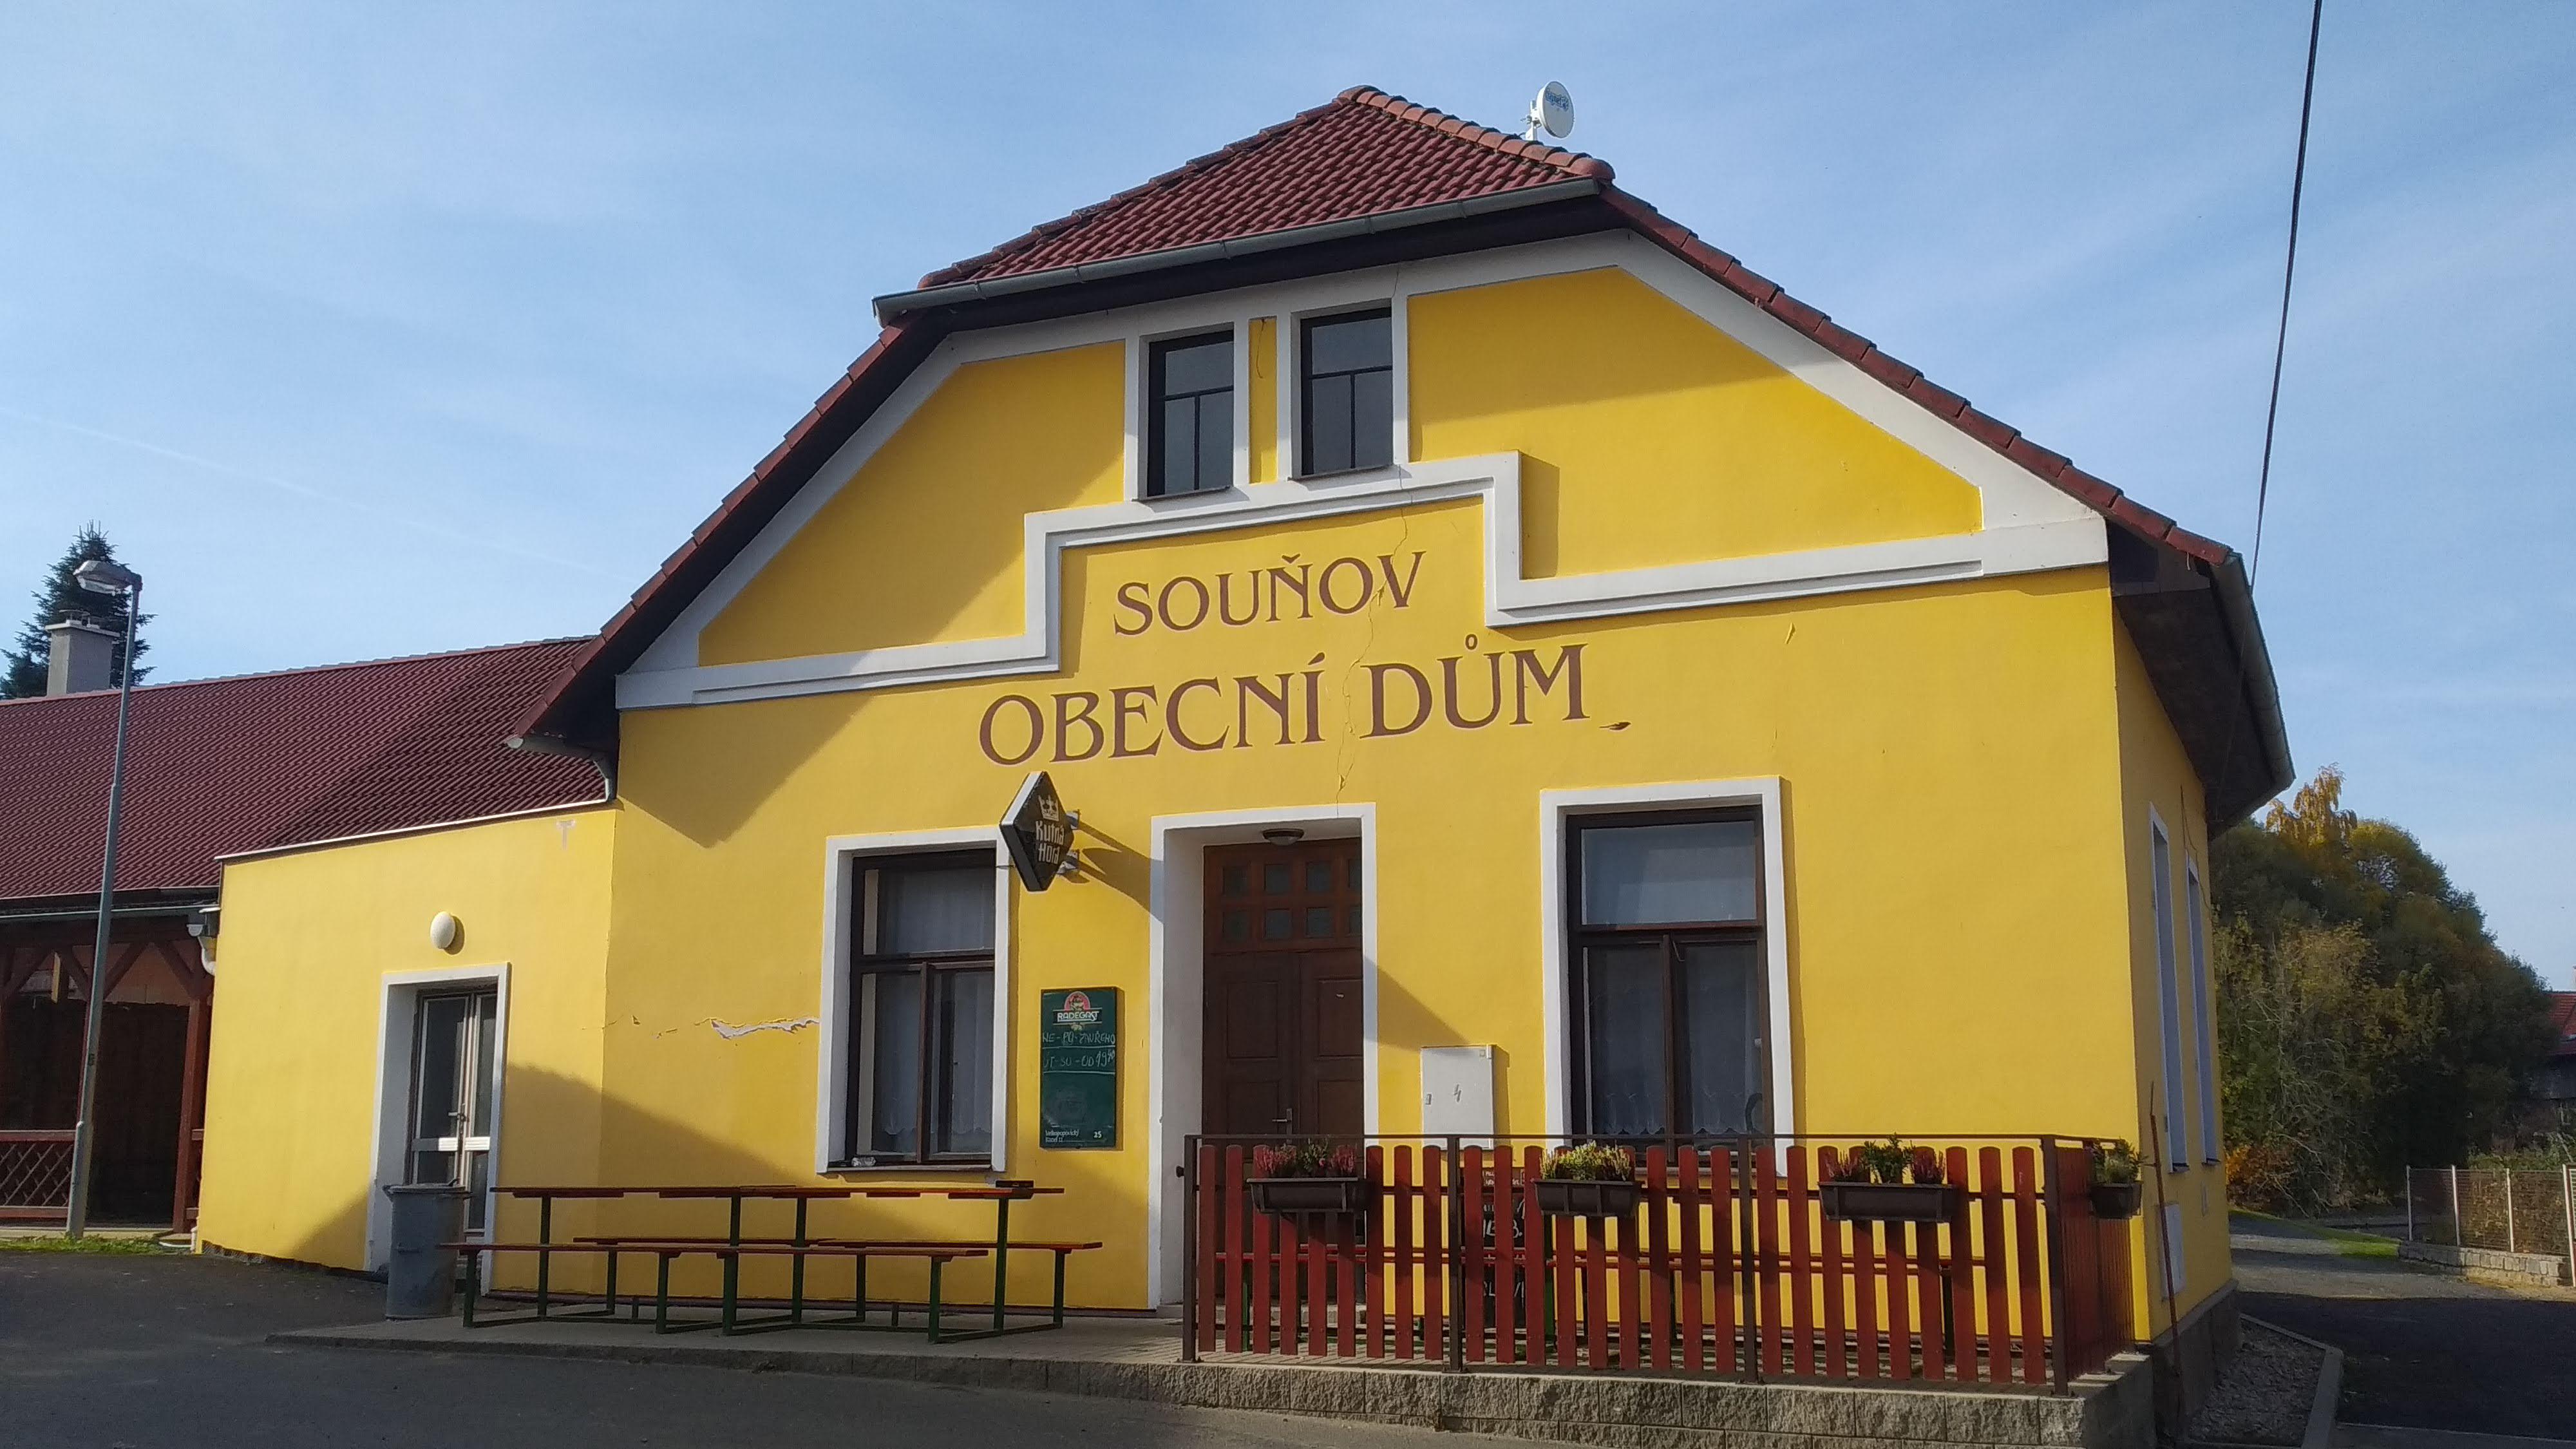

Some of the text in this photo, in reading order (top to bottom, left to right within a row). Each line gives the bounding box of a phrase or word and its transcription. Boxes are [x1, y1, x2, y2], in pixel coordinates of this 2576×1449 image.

[1113, 551, 1427, 635] SOUŇOV
[979, 634, 1591, 765] OBECNÍ DŮM
[1036, 820, 1065, 846] Kutná
[1038, 842, 1060, 865] Hora
[1057, 1010, 1100, 1023] RADEGAST
